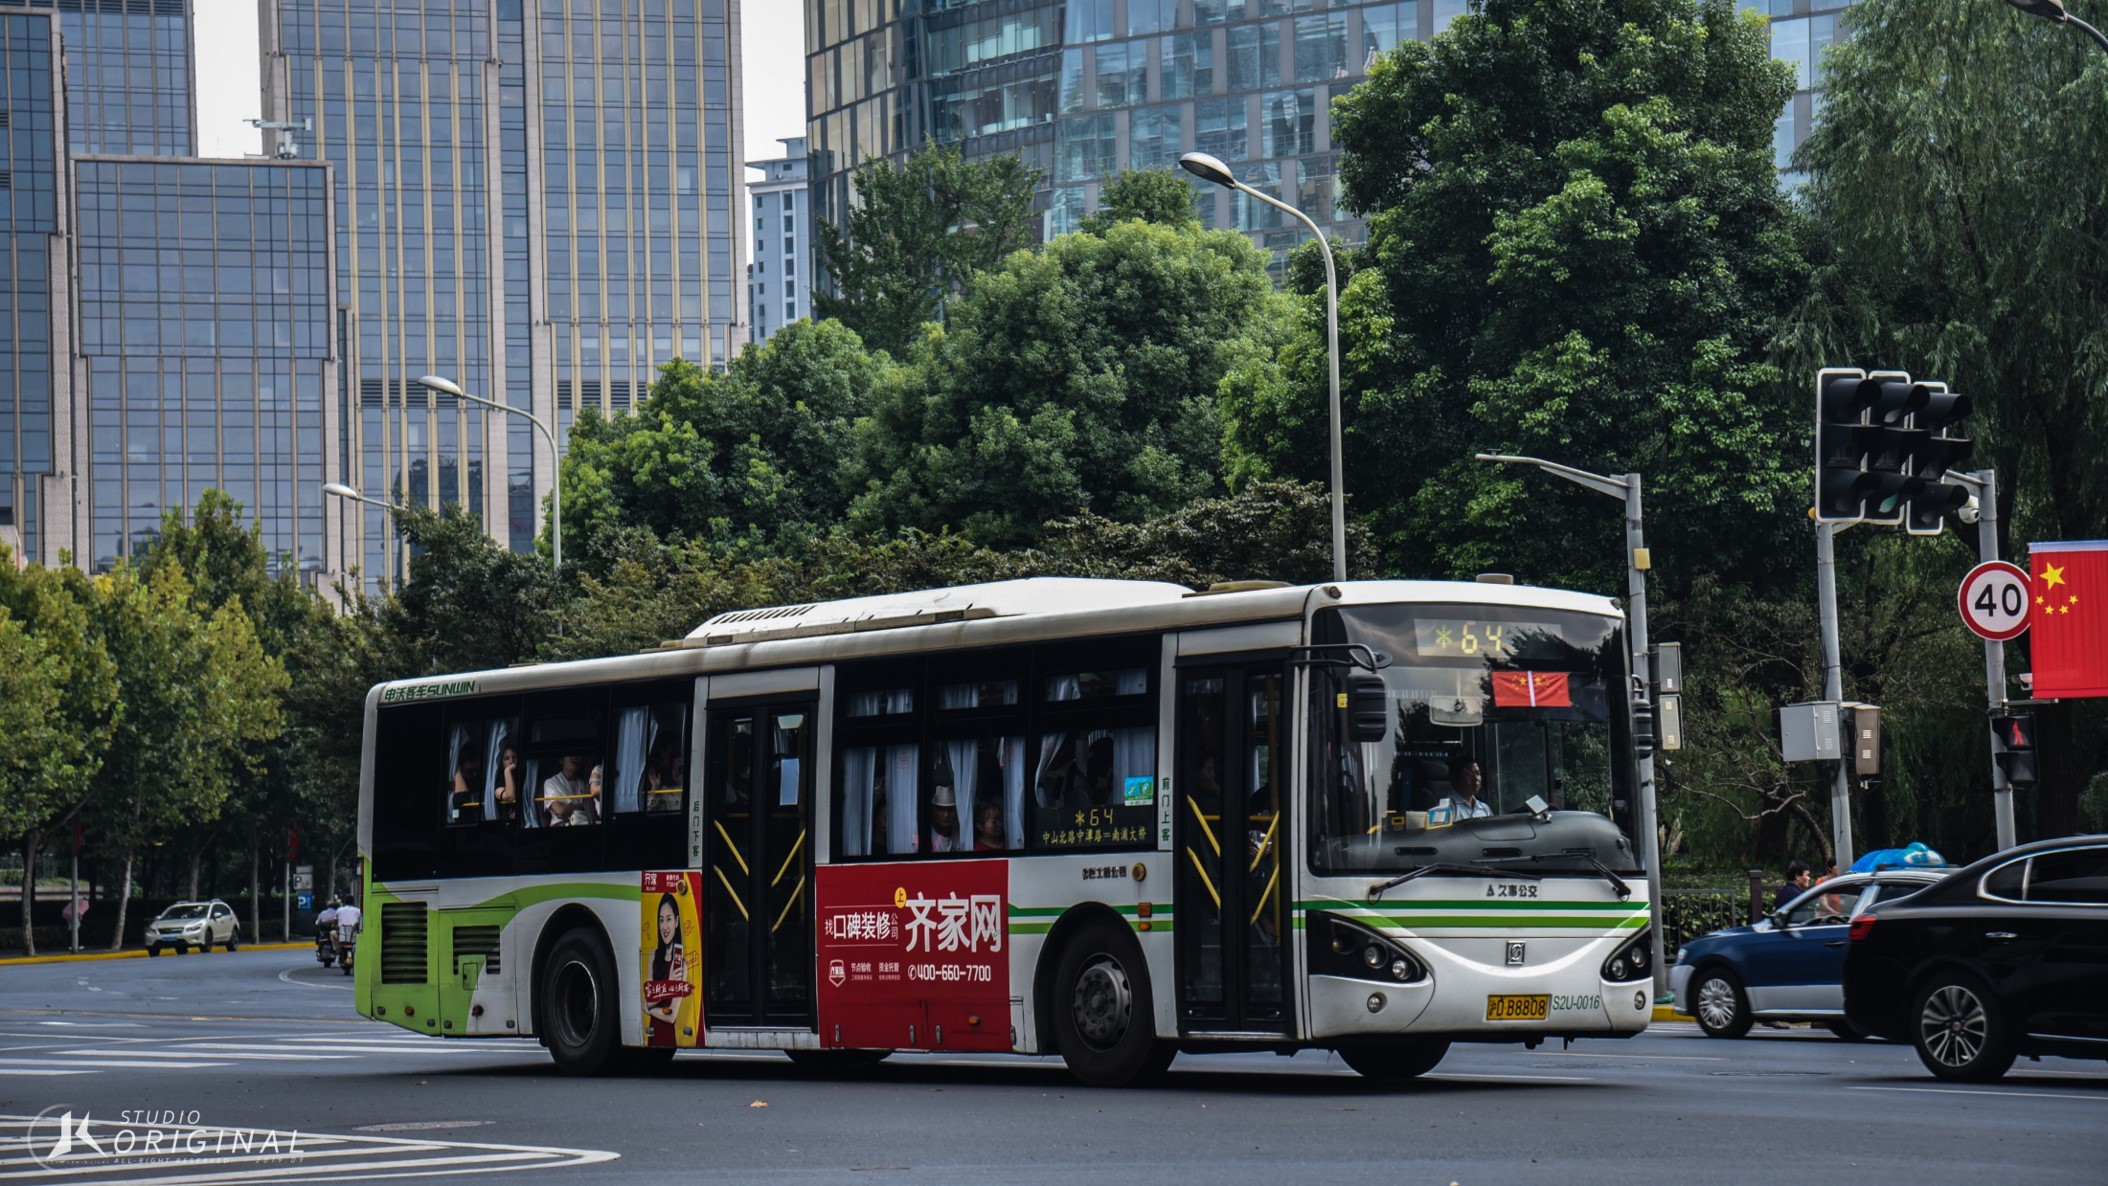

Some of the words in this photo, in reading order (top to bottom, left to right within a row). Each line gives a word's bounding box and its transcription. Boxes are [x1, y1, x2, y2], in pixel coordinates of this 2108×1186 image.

[1974, 583, 2022, 617] 40
[1161, 776, 1170, 842] 前门上客
[692, 800, 700, 857] 后门下客
[294, 876, 302, 888] P
[897, 889, 904, 903] 上
[1498, 884, 1538, 898] 久事公交
[298, 896, 307, 909] P
[904, 891, 1003, 953] 齐家网
[917, 964, 991, 982] 400-660-7700
[1552, 995, 1600, 1011] S2U-0016
